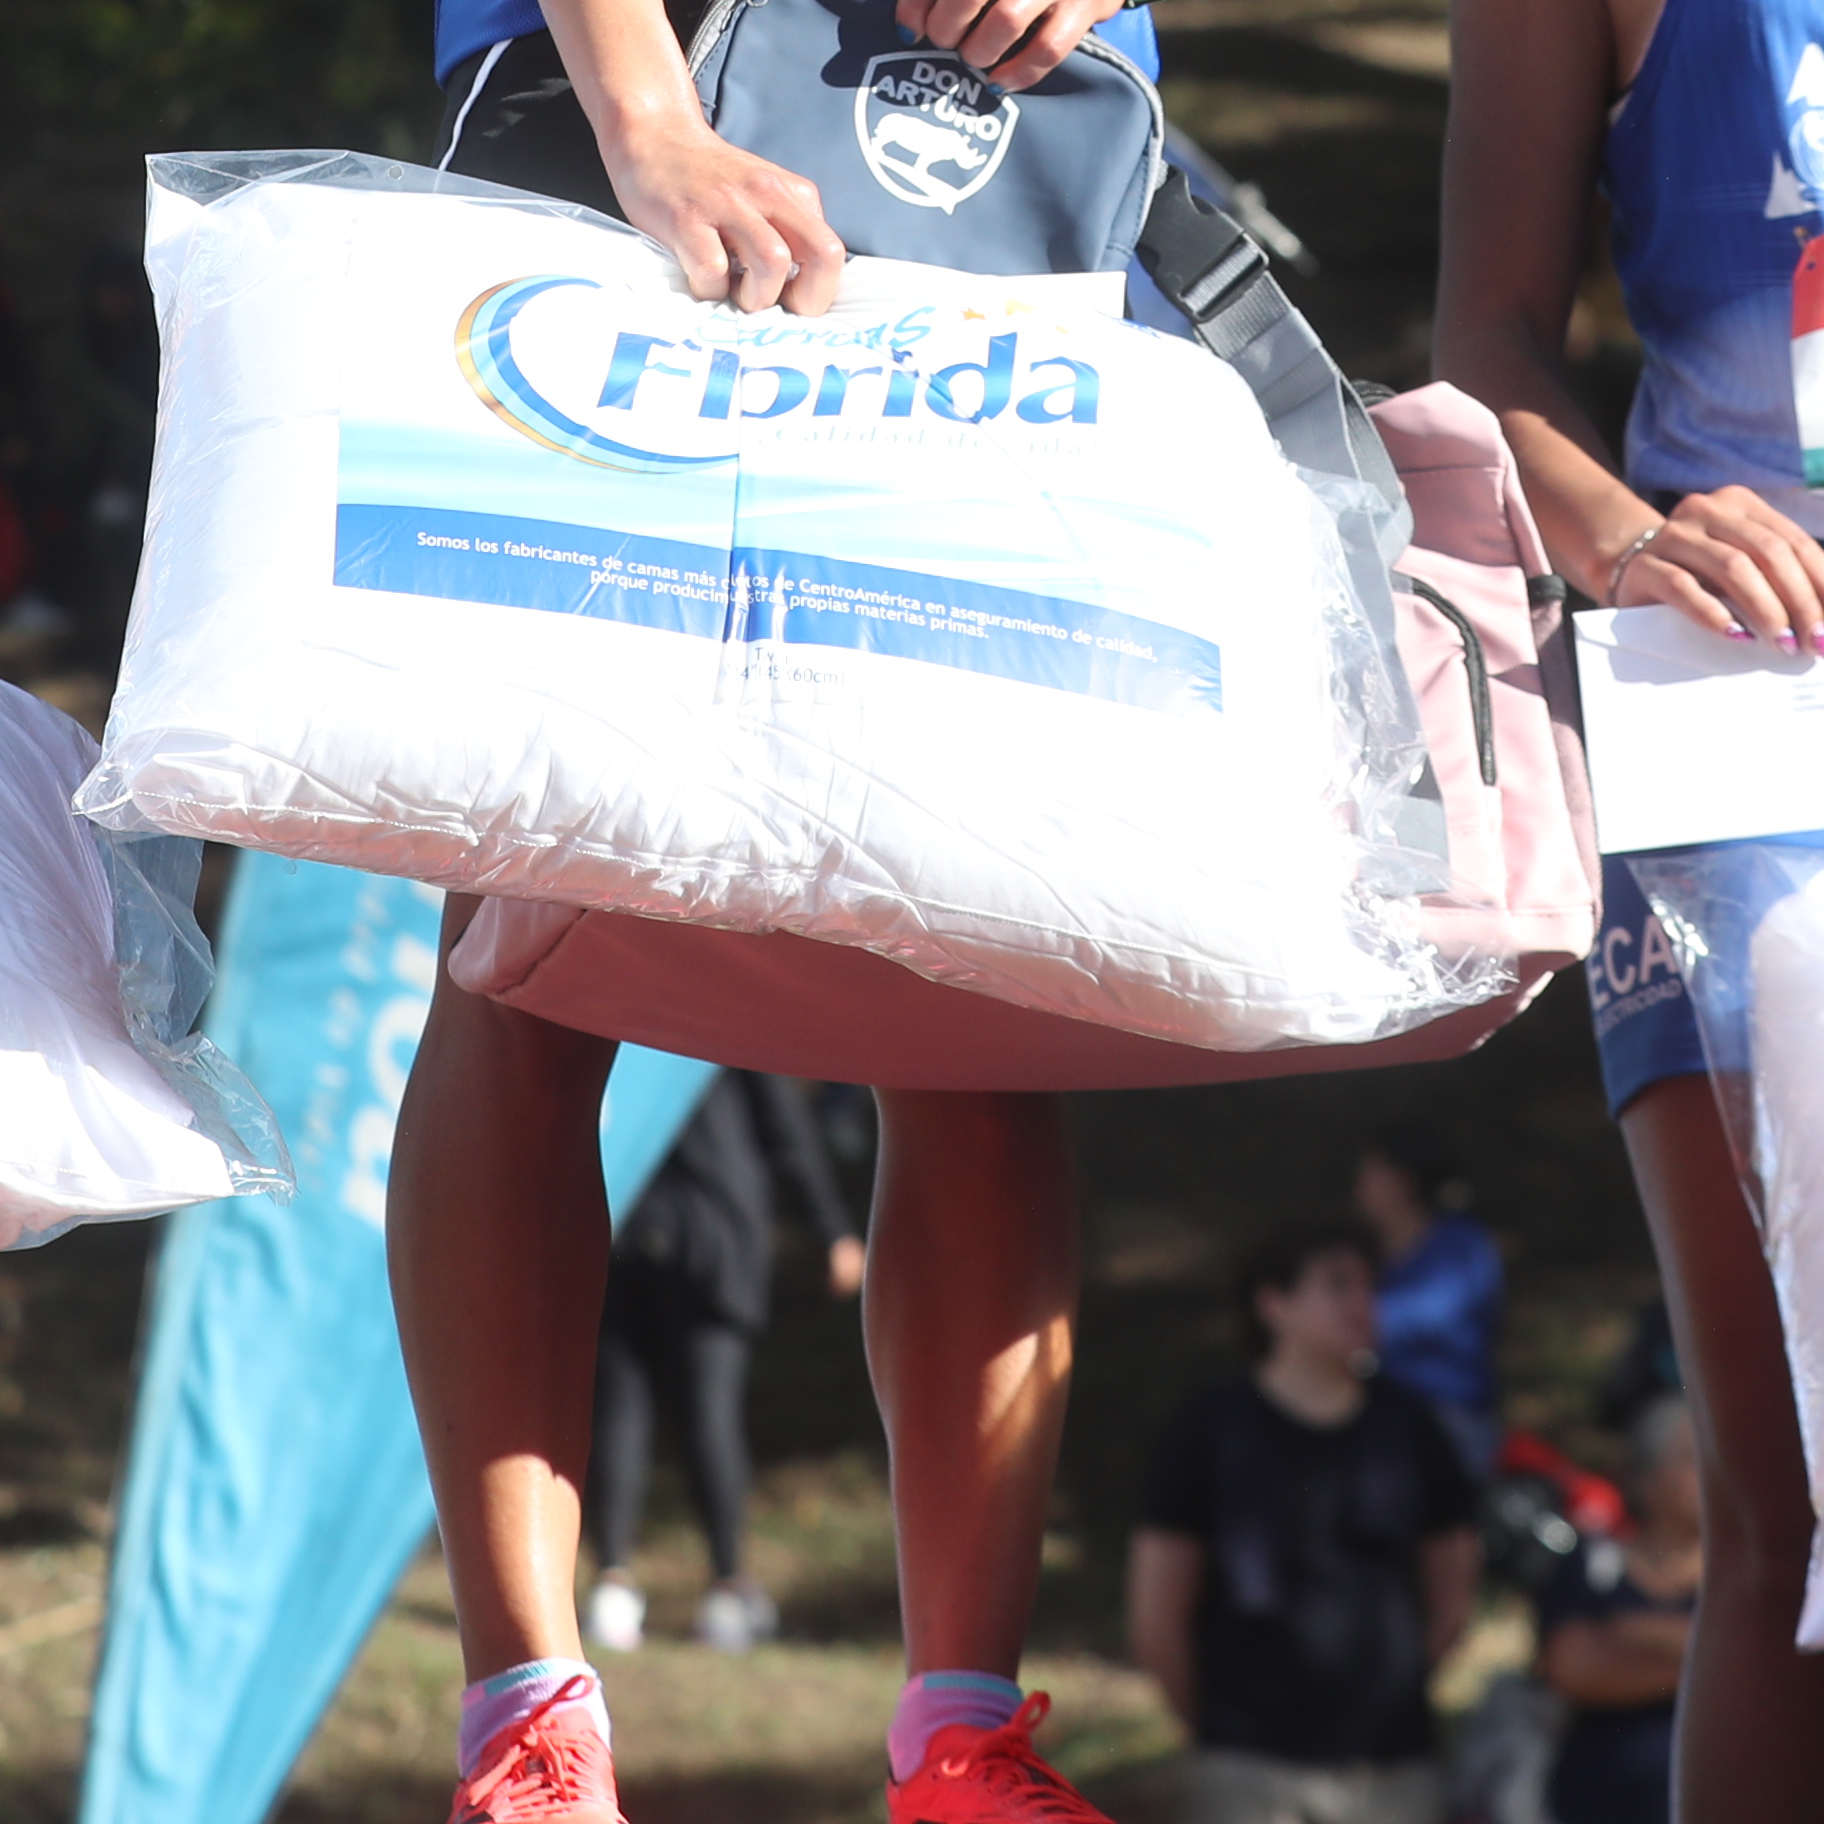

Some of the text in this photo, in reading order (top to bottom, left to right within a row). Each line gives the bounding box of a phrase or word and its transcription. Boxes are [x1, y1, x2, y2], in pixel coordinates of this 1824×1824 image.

[871, 74, 1002, 142] ARTURO
[911, 60, 982, 105] DON
[416, 531, 471, 552] Somos
[474, 537, 499, 556] los
[503, 540, 597, 568] fabricantes
[601, 555, 623, 572] de
[626, 561, 680, 582] camas
[683, 570, 717, 587] más
[799, 578, 921, 613] CentroAmérica
[925, 601, 946, 616] en
[950, 605, 1069, 642] aseguramiento
[1071, 627, 1093, 647] de
[1095, 632, 1159, 665] calidad,
[589, 570, 649, 594] porque
[789, 593, 850, 617] propias
[854, 603, 926, 628] materias
[930, 616, 990, 640] primas.
